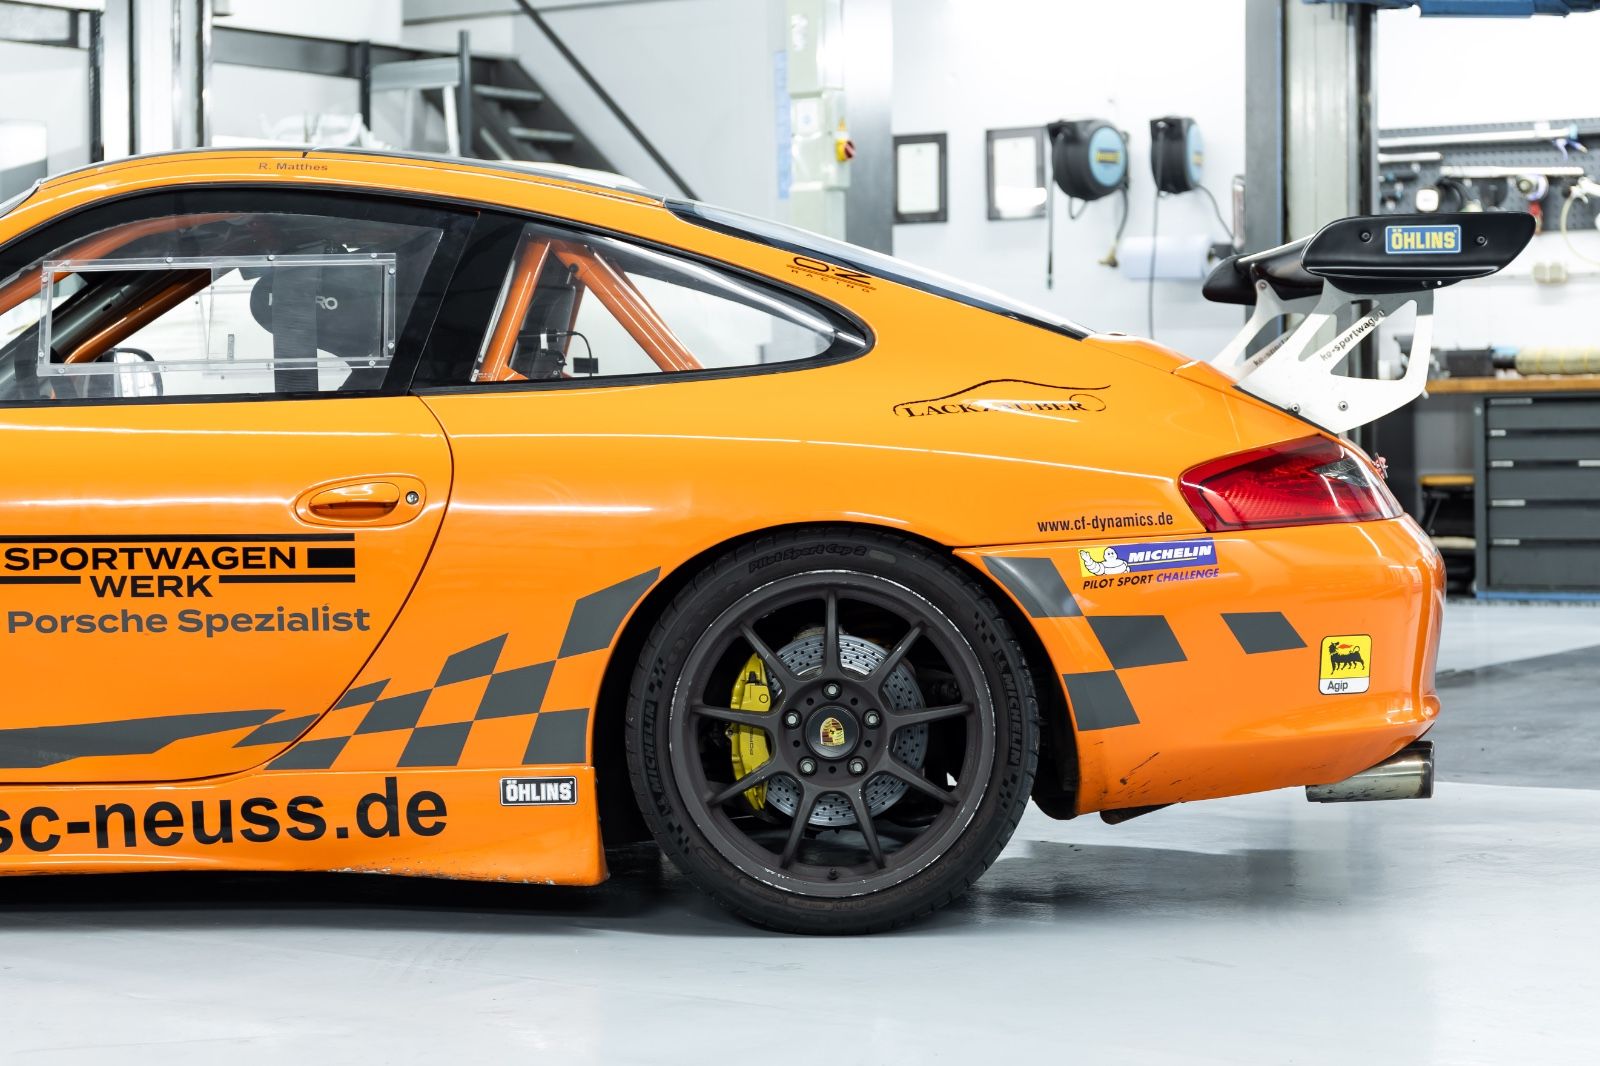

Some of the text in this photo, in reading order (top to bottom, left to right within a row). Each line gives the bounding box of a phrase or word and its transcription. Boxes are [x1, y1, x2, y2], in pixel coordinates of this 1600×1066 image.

[258, 162, 329, 171] R. Matthes
[1391, 228, 1456, 250] ÖHLINS
[1037, 512, 1173, 532] www.cf-dynamics.de
[4, 546, 296, 571] SPORTWAGEN
[783, 545, 825, 561] Sport
[826, 543, 853, 556] Cup
[853, 545, 867, 557] 2
[1128, 545, 1213, 563] MICHELIN
[89, 575, 213, 598] WERK
[1083, 568, 1219, 590] PILOT SPORT CHALLENGE
[8, 605, 370, 638] Porsche Spezialist
[1327, 680, 1349, 692] Agip
[1003, 674, 1022, 766] MICHELIN
[643, 701, 664, 792] MICHELIN
[505, 780, 573, 802] ÖHLINS
